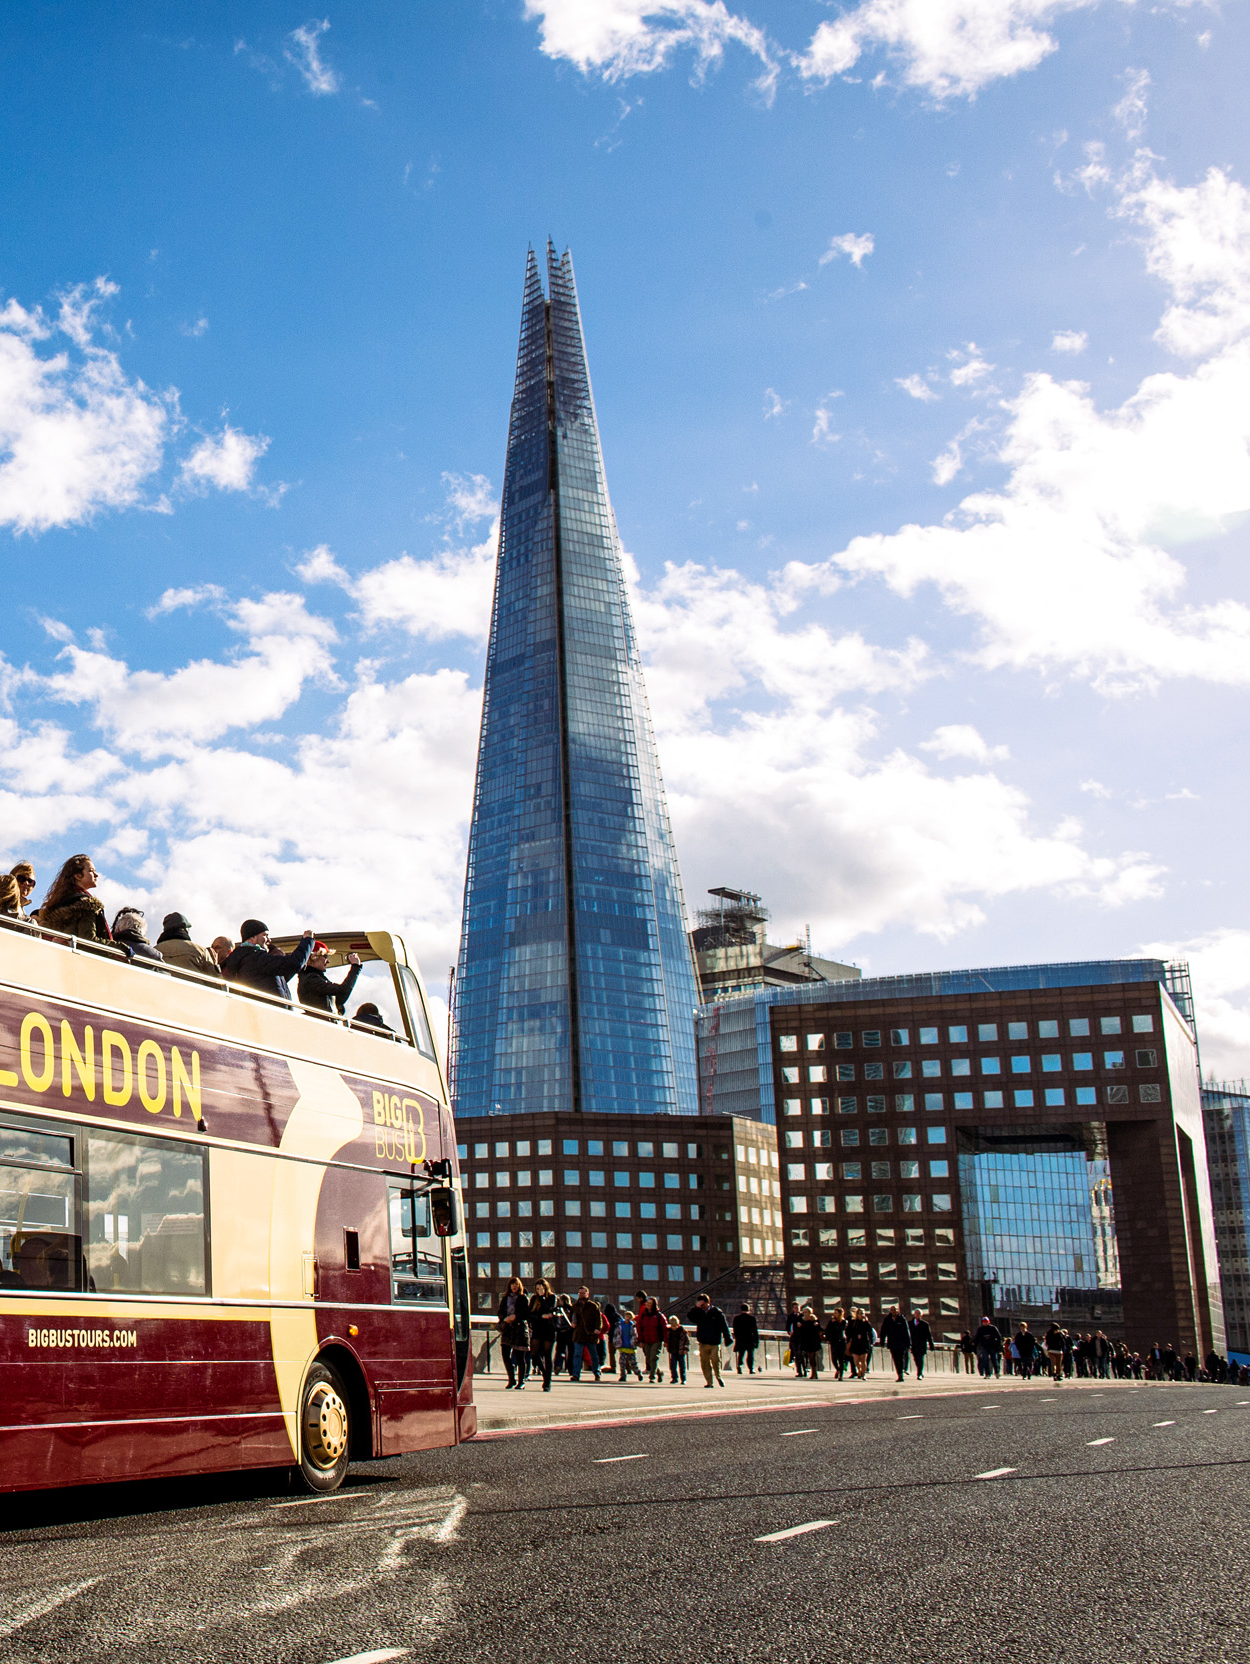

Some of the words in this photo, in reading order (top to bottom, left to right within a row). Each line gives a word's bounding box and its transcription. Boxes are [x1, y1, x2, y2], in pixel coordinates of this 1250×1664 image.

[372, 1090, 402, 1129] BIG
[374, 1126, 405, 1162] BUS
[28, 1329, 137, 1348] BIGBUSTOURS.COM
